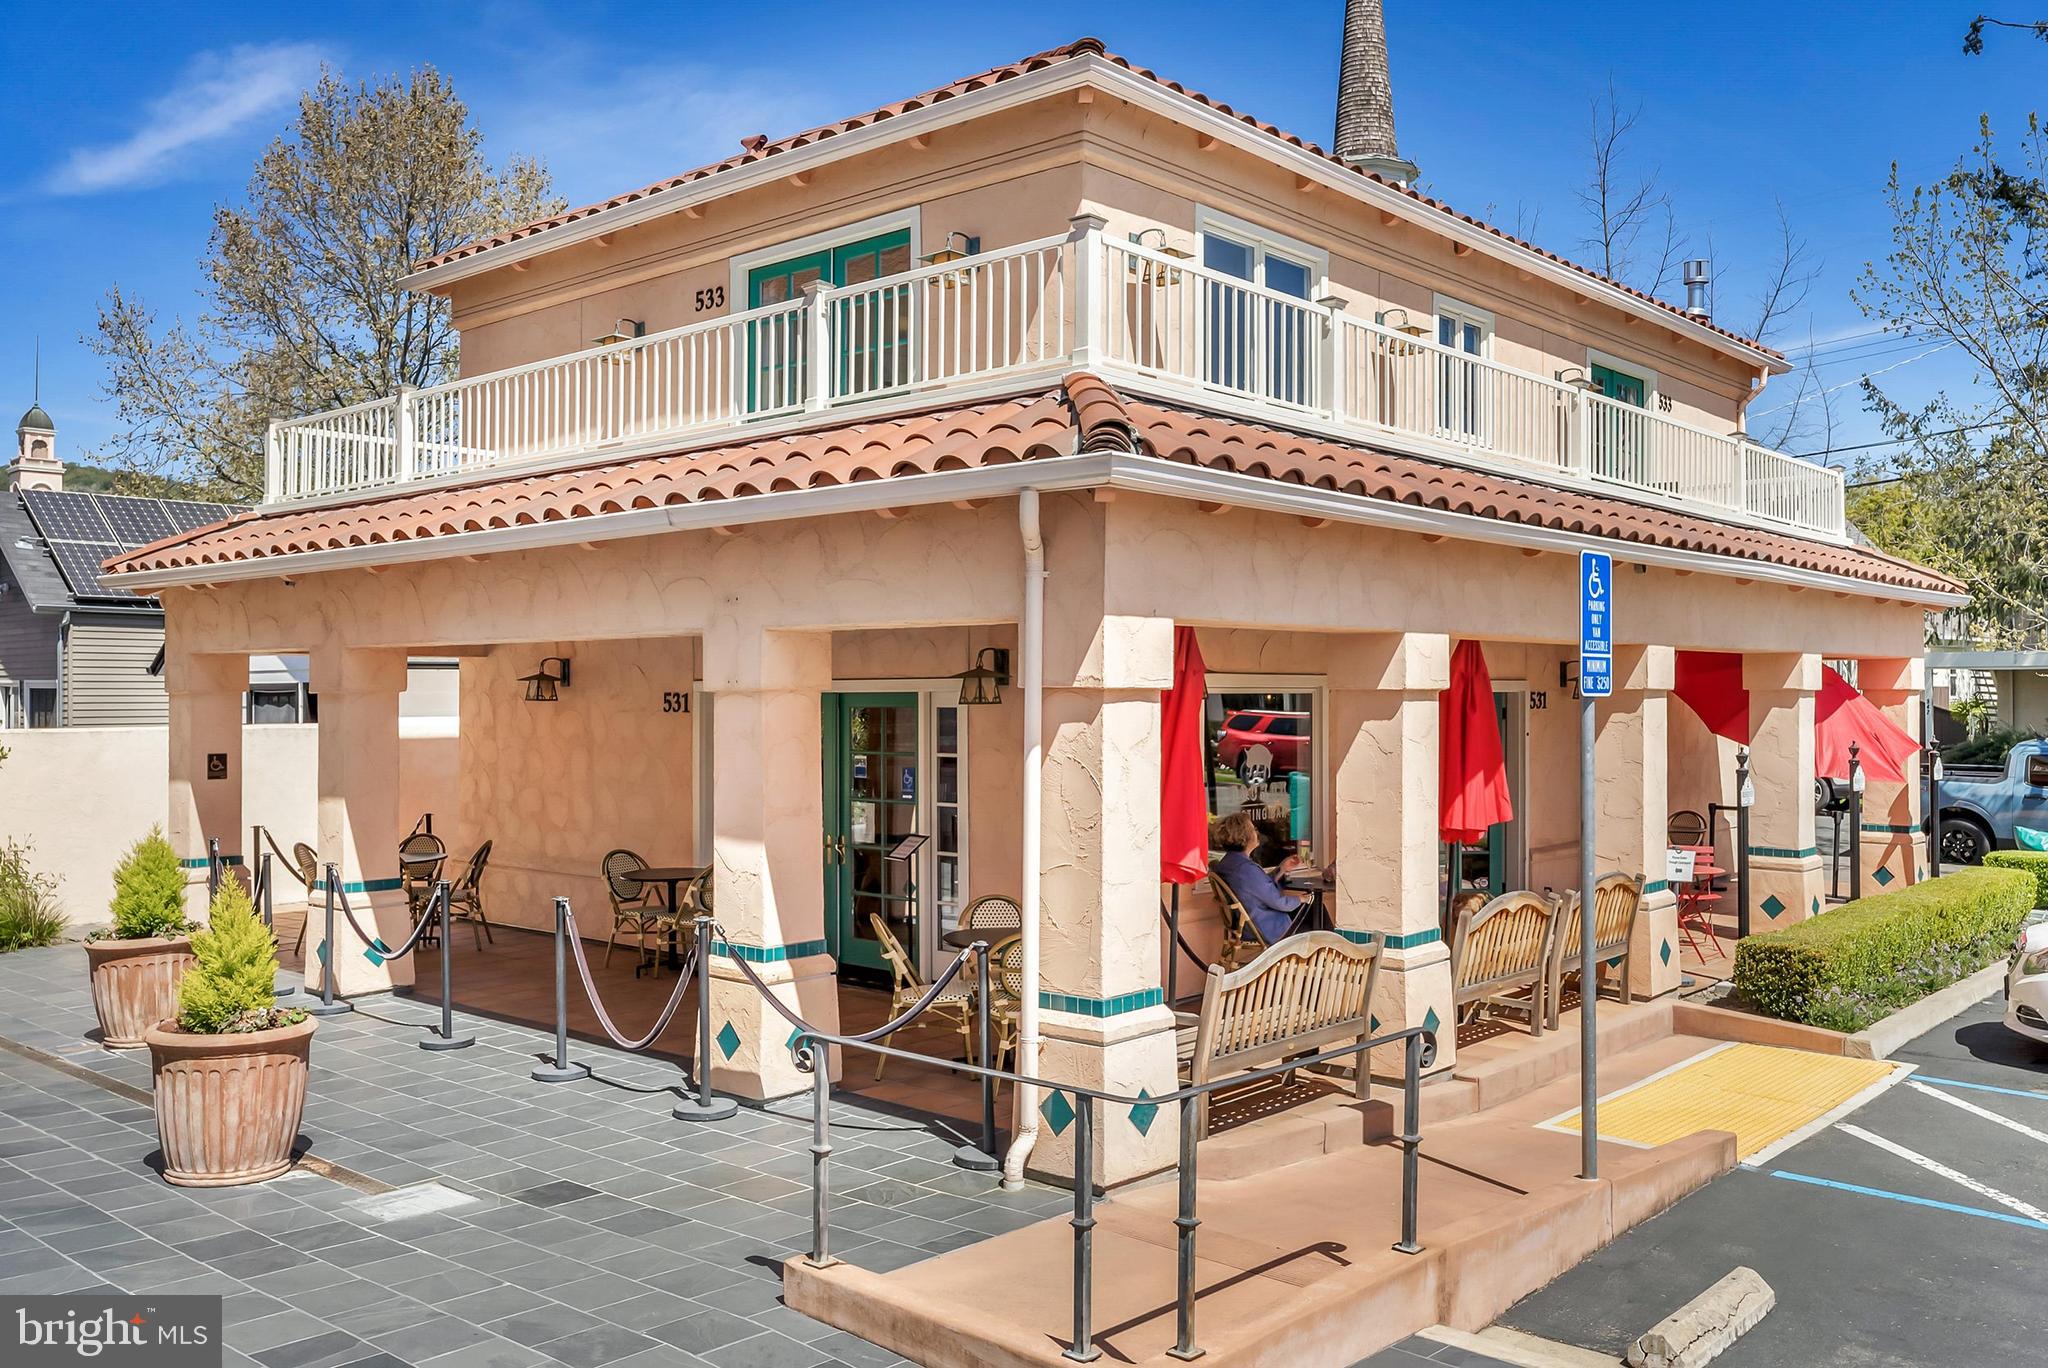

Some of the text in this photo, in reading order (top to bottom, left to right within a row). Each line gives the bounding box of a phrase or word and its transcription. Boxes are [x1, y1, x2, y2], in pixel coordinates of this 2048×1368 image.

[695, 286, 725, 312] 533
[1659, 393, 1672, 413] 533
[1588, 600, 1605, 611] PARKING
[1591, 614, 1602, 624] ONLY
[1585, 639, 1608, 652] ACCESSIBLE
[1587, 659, 1606, 672] MINIMUM
[1584, 676, 1609, 690] FINE $250
[663, 691, 690, 713] 531
[1530, 691, 1547, 709] 531
